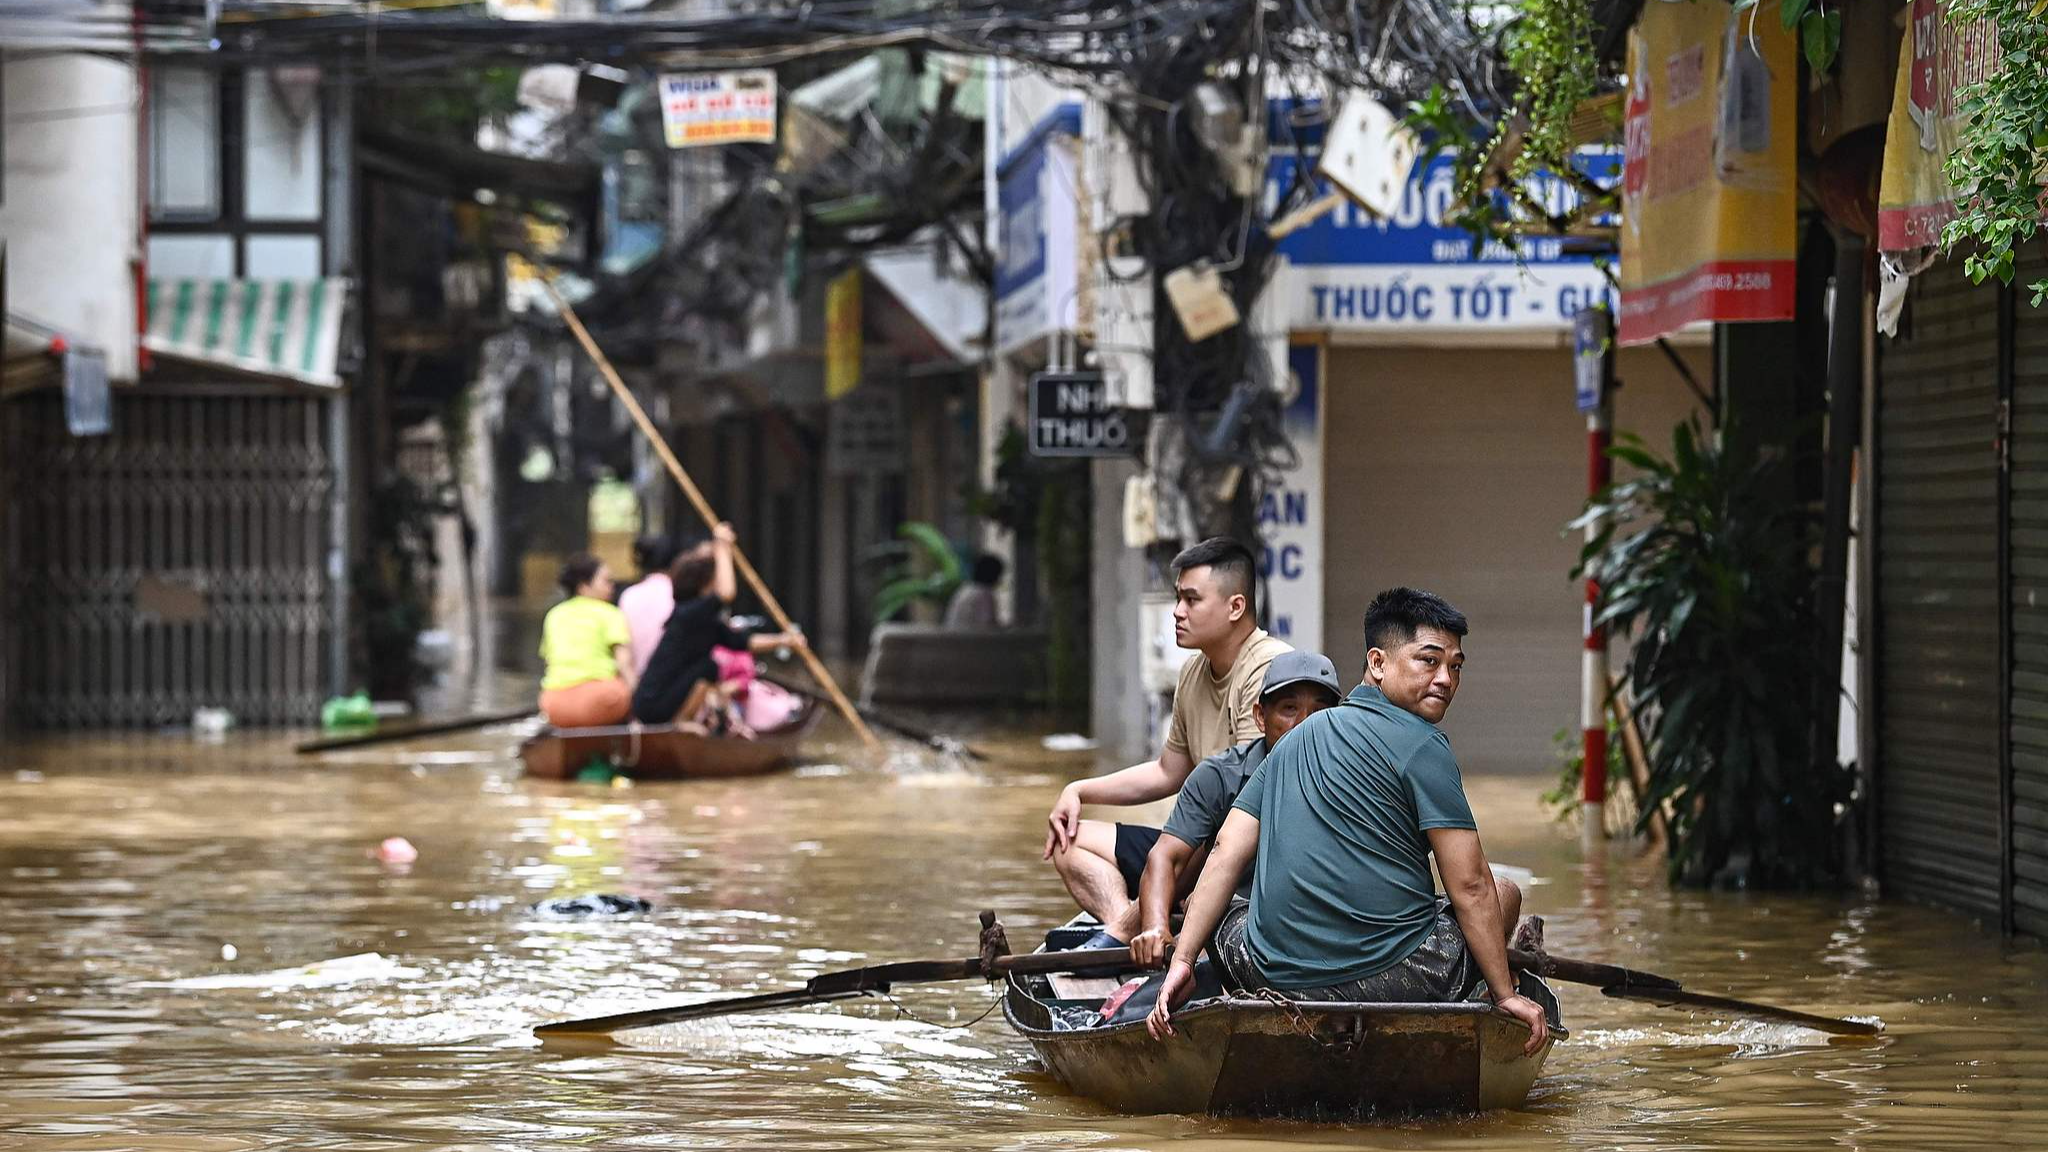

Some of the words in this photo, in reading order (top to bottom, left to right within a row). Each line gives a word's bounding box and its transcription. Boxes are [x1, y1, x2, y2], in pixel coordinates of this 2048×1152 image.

[1311, 270, 1433, 322] THUỐC
[1449, 271, 1514, 321] TỐT
[1057, 382, 1106, 413] NH
